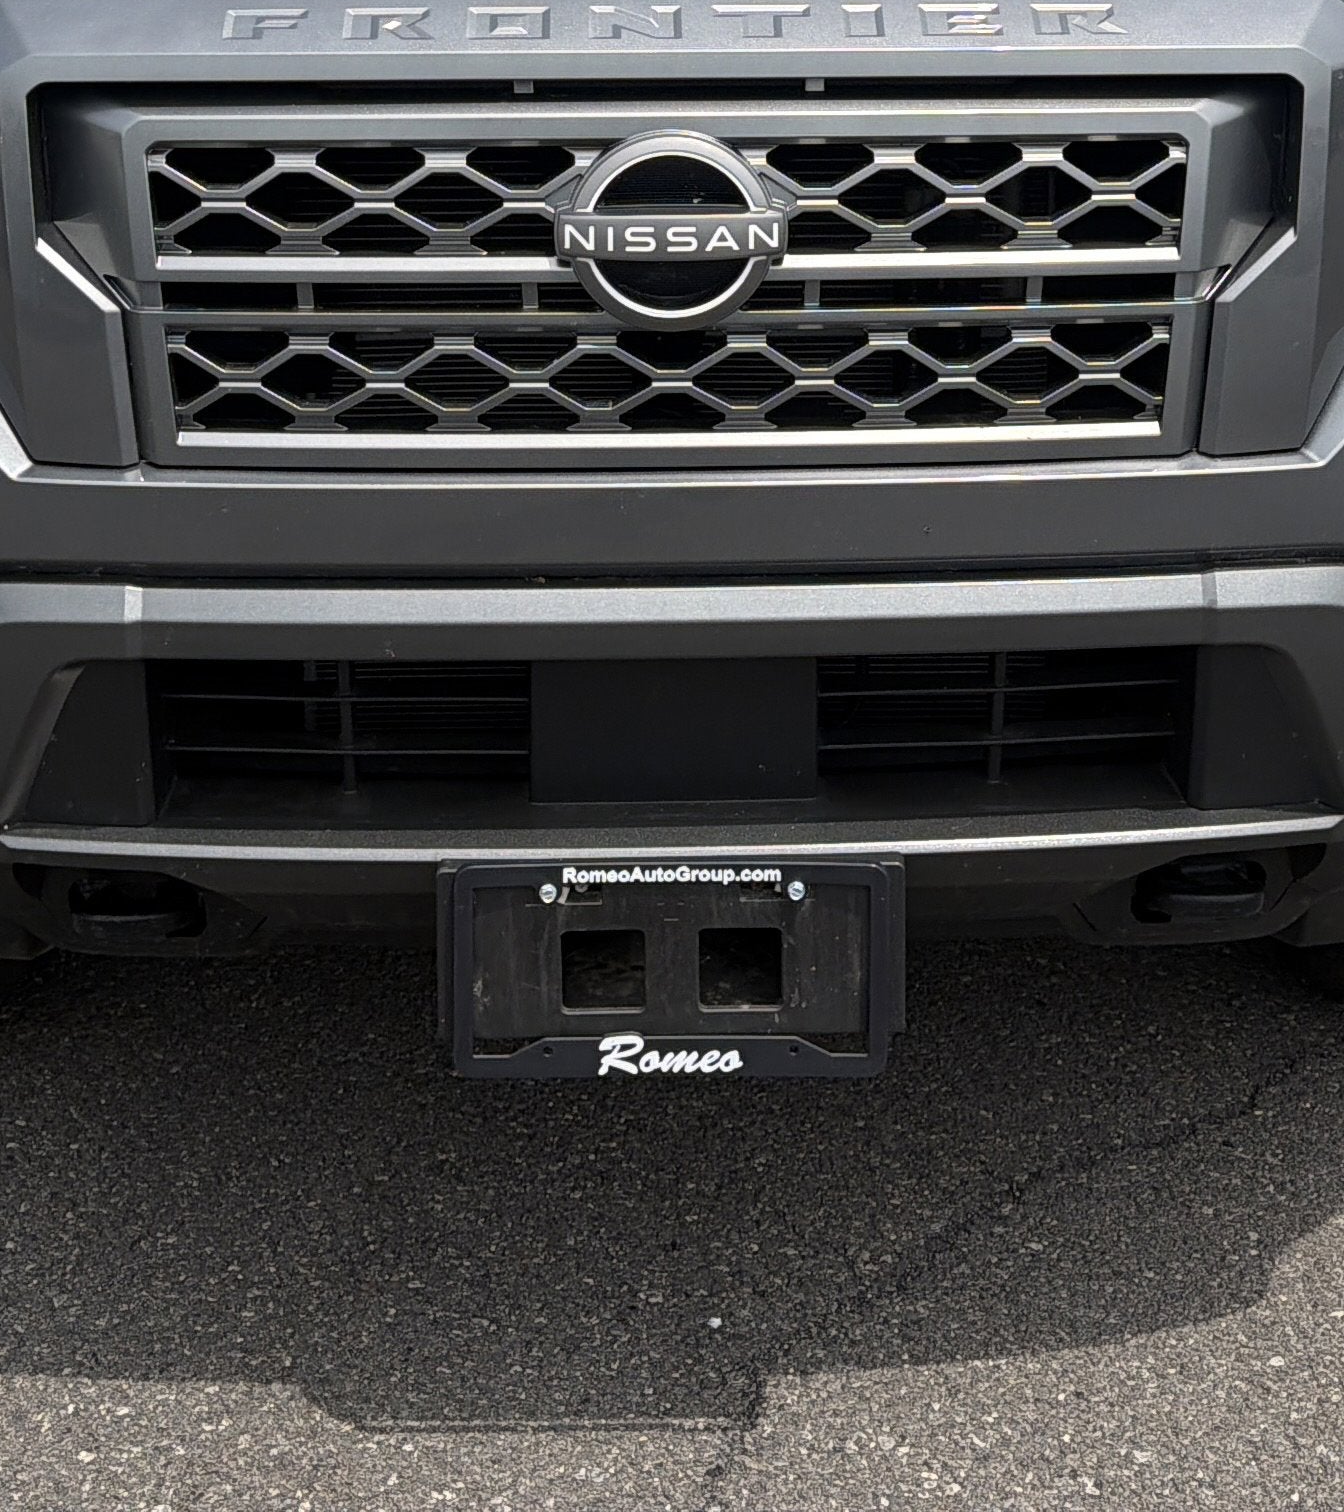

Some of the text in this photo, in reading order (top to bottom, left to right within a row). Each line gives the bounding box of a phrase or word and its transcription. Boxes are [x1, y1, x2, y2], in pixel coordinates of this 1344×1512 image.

[220, 2, 1132, 40] FRONTIER
[563, 222, 779, 253] NISSAN
[562, 866, 782, 885] RomeoAutoGroup.com
[597, 1034, 744, 1076] Romeo
